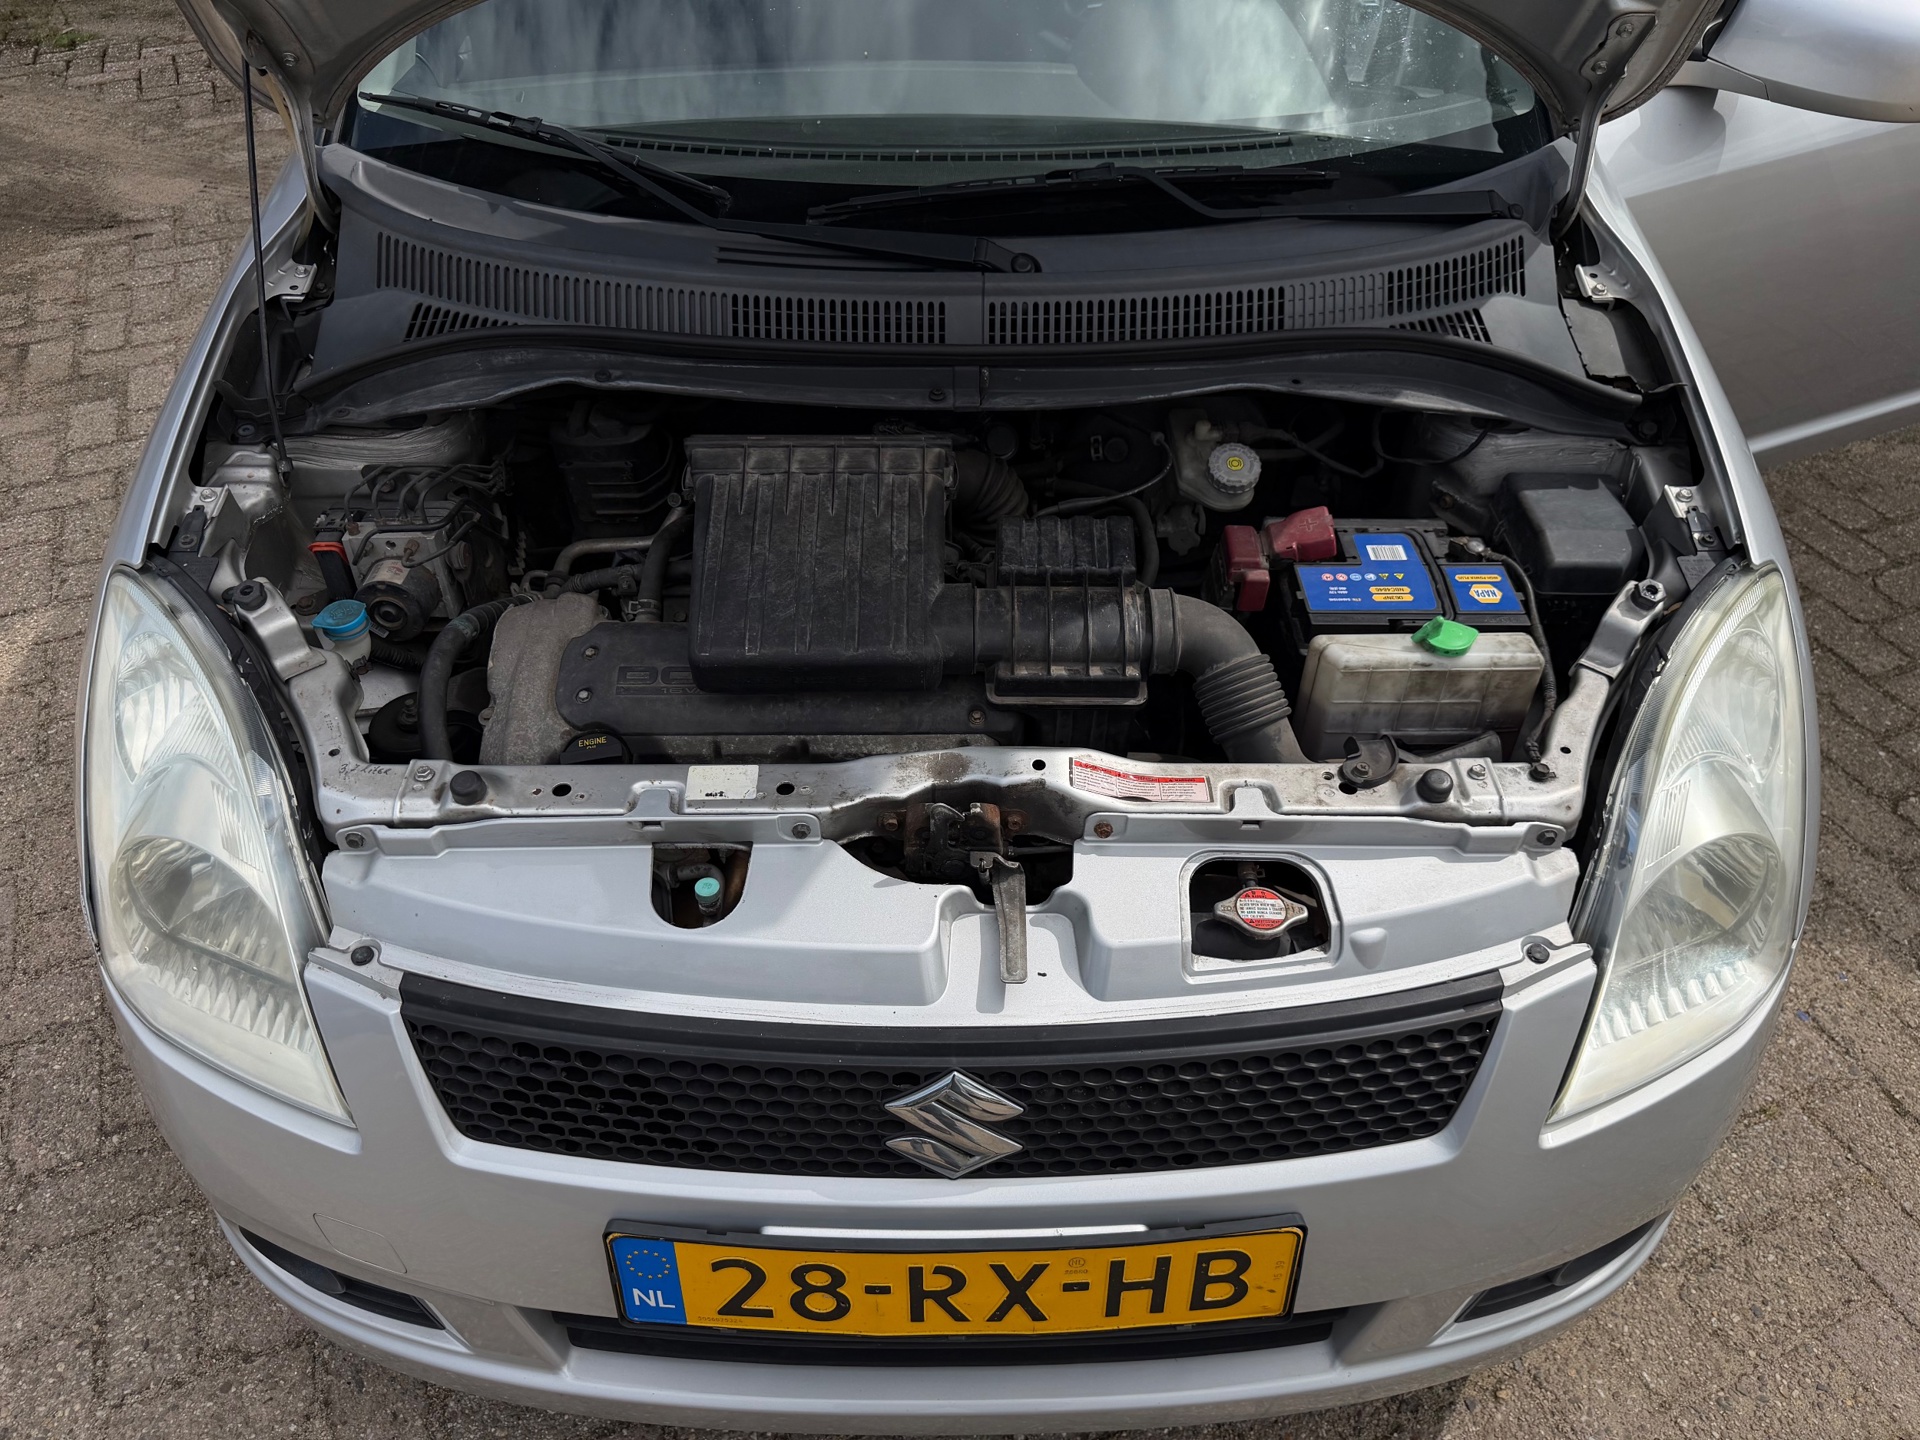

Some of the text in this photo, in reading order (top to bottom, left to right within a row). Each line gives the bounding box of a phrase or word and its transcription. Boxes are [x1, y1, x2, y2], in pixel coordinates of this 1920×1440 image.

[1473, 589, 1498, 598] NAPA
[578, 736, 607, 747] ENGINE
[632, 1249, 1251, 1322] NL 28-RX-HB
